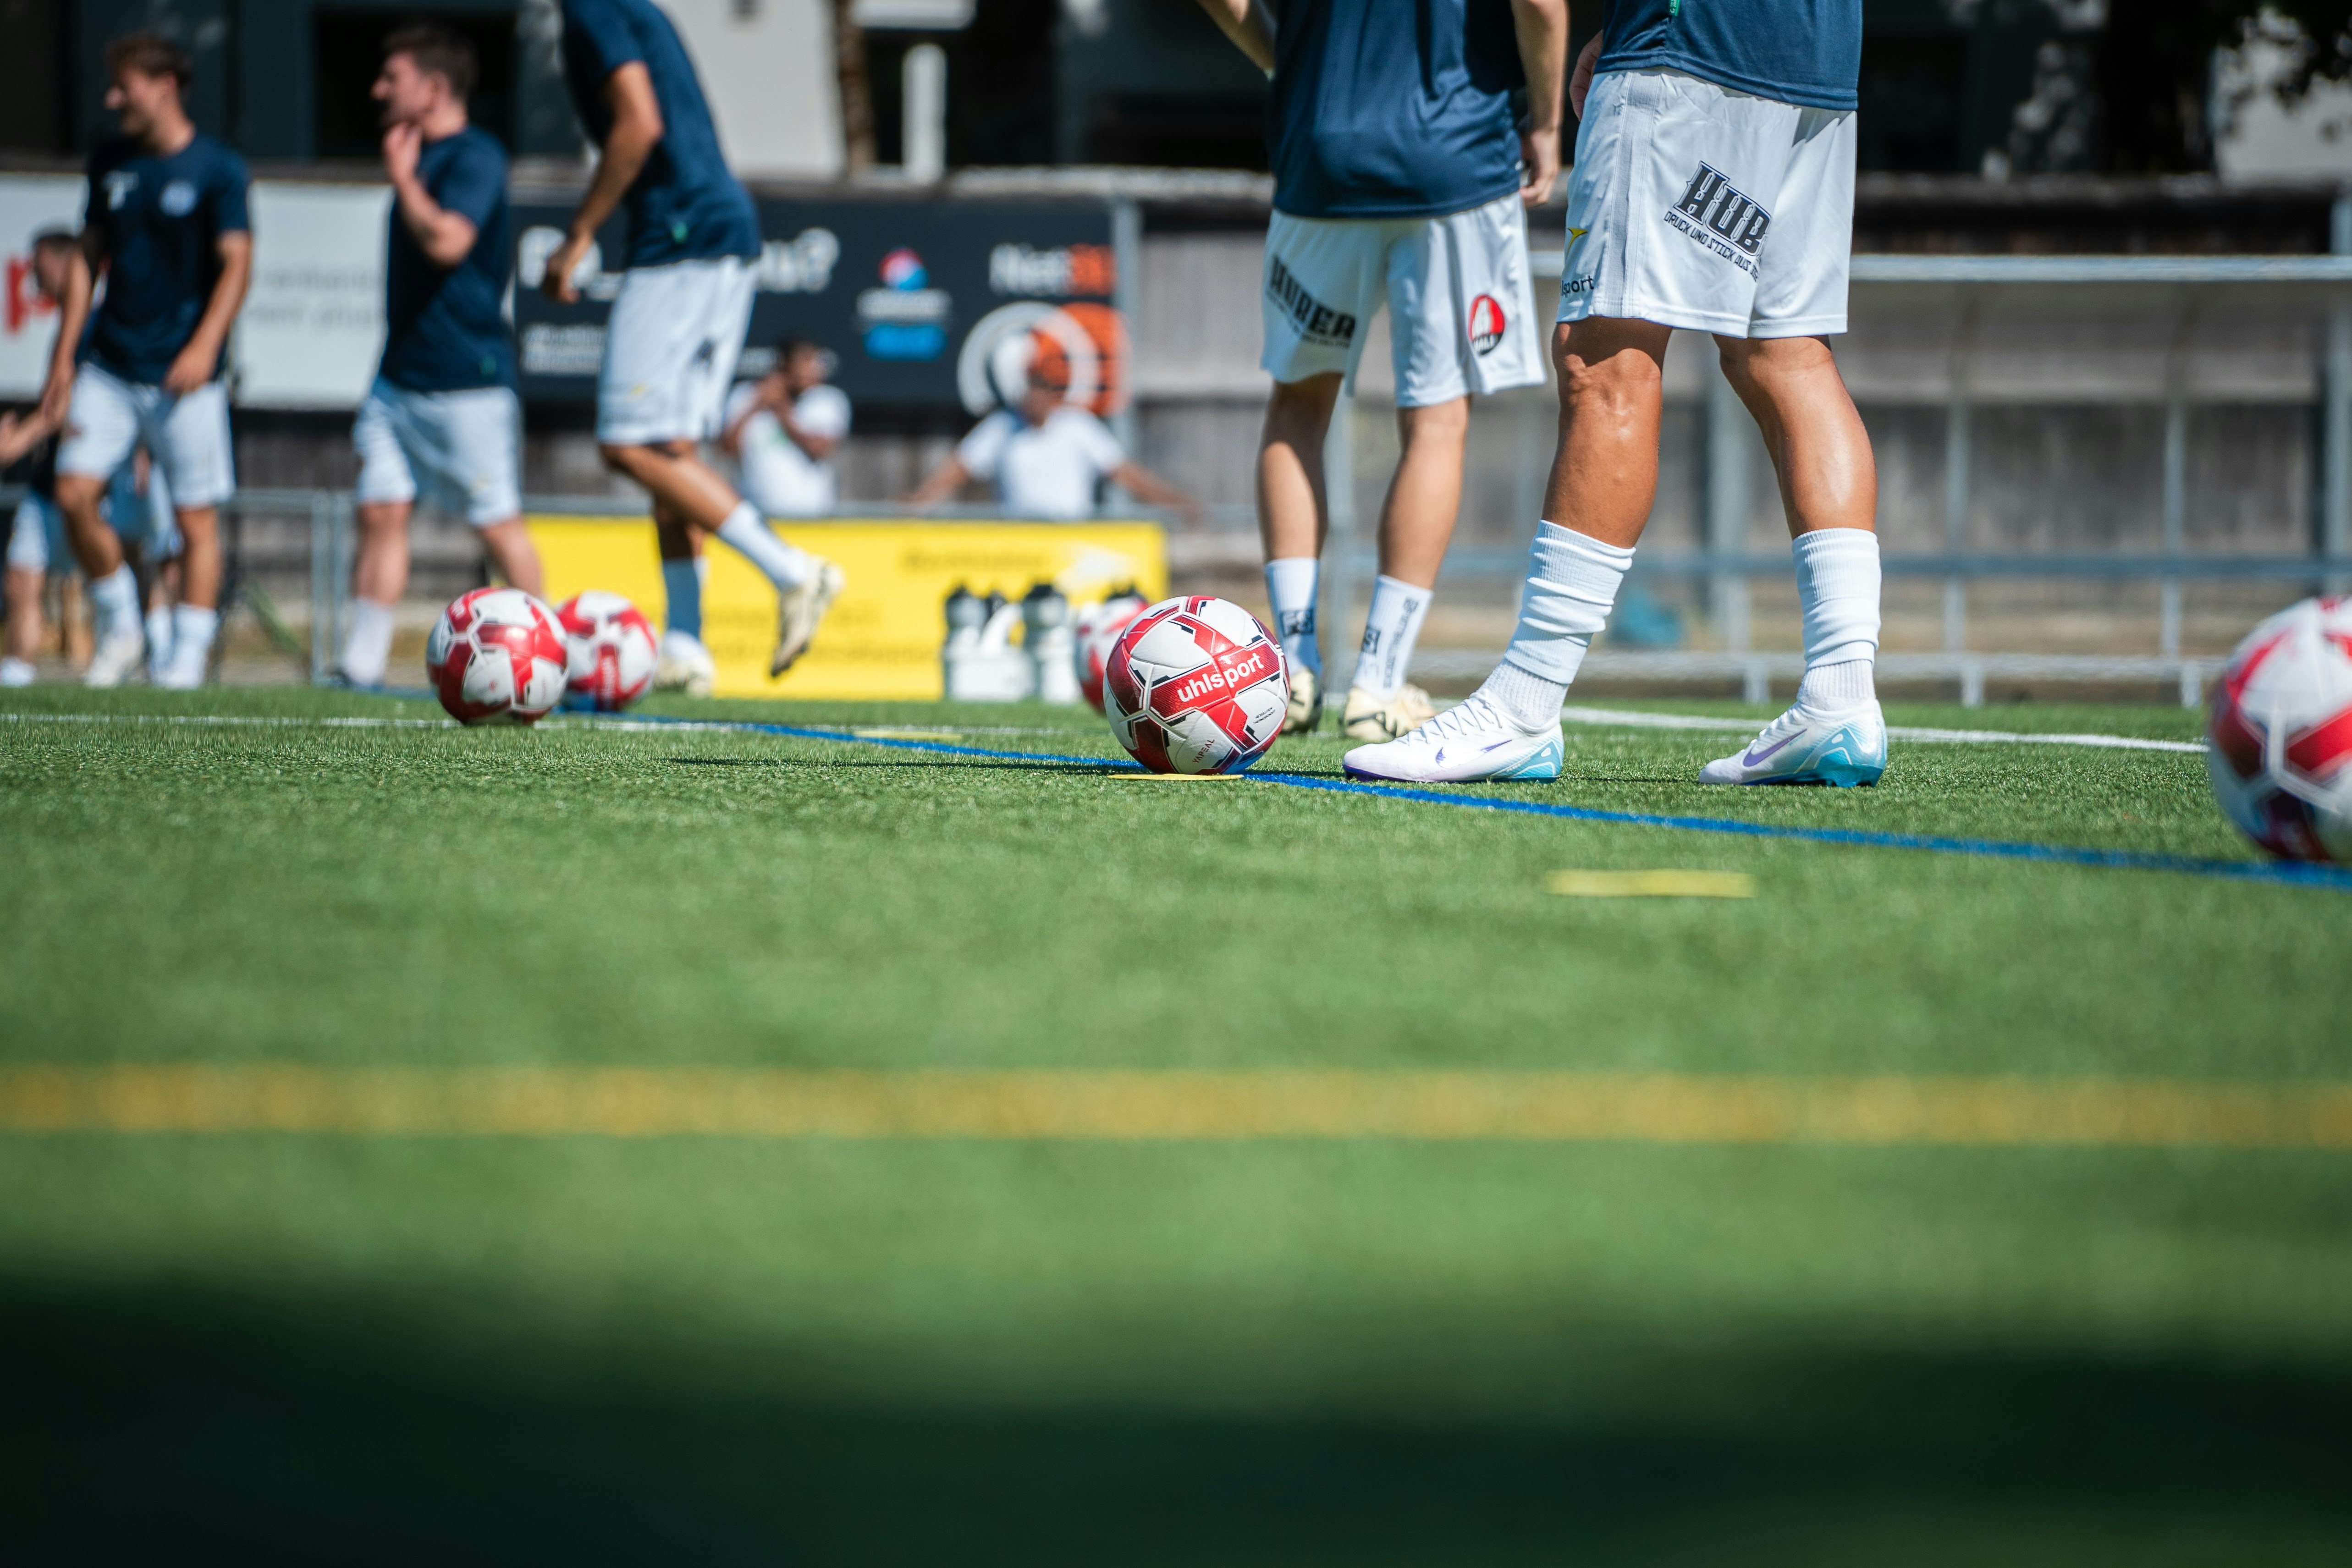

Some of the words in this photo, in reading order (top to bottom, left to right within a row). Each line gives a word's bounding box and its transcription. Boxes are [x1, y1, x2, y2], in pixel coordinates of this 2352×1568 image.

[1663, 210, 1692, 235] DRUCK
[1690, 227, 1709, 245] UND
[1706, 237, 1736, 261] STICK
[1734, 254, 1752, 271] AUS
[1177, 653, 1265, 702] uhlsport
[1192, 739, 1215, 763] YAPEAL
